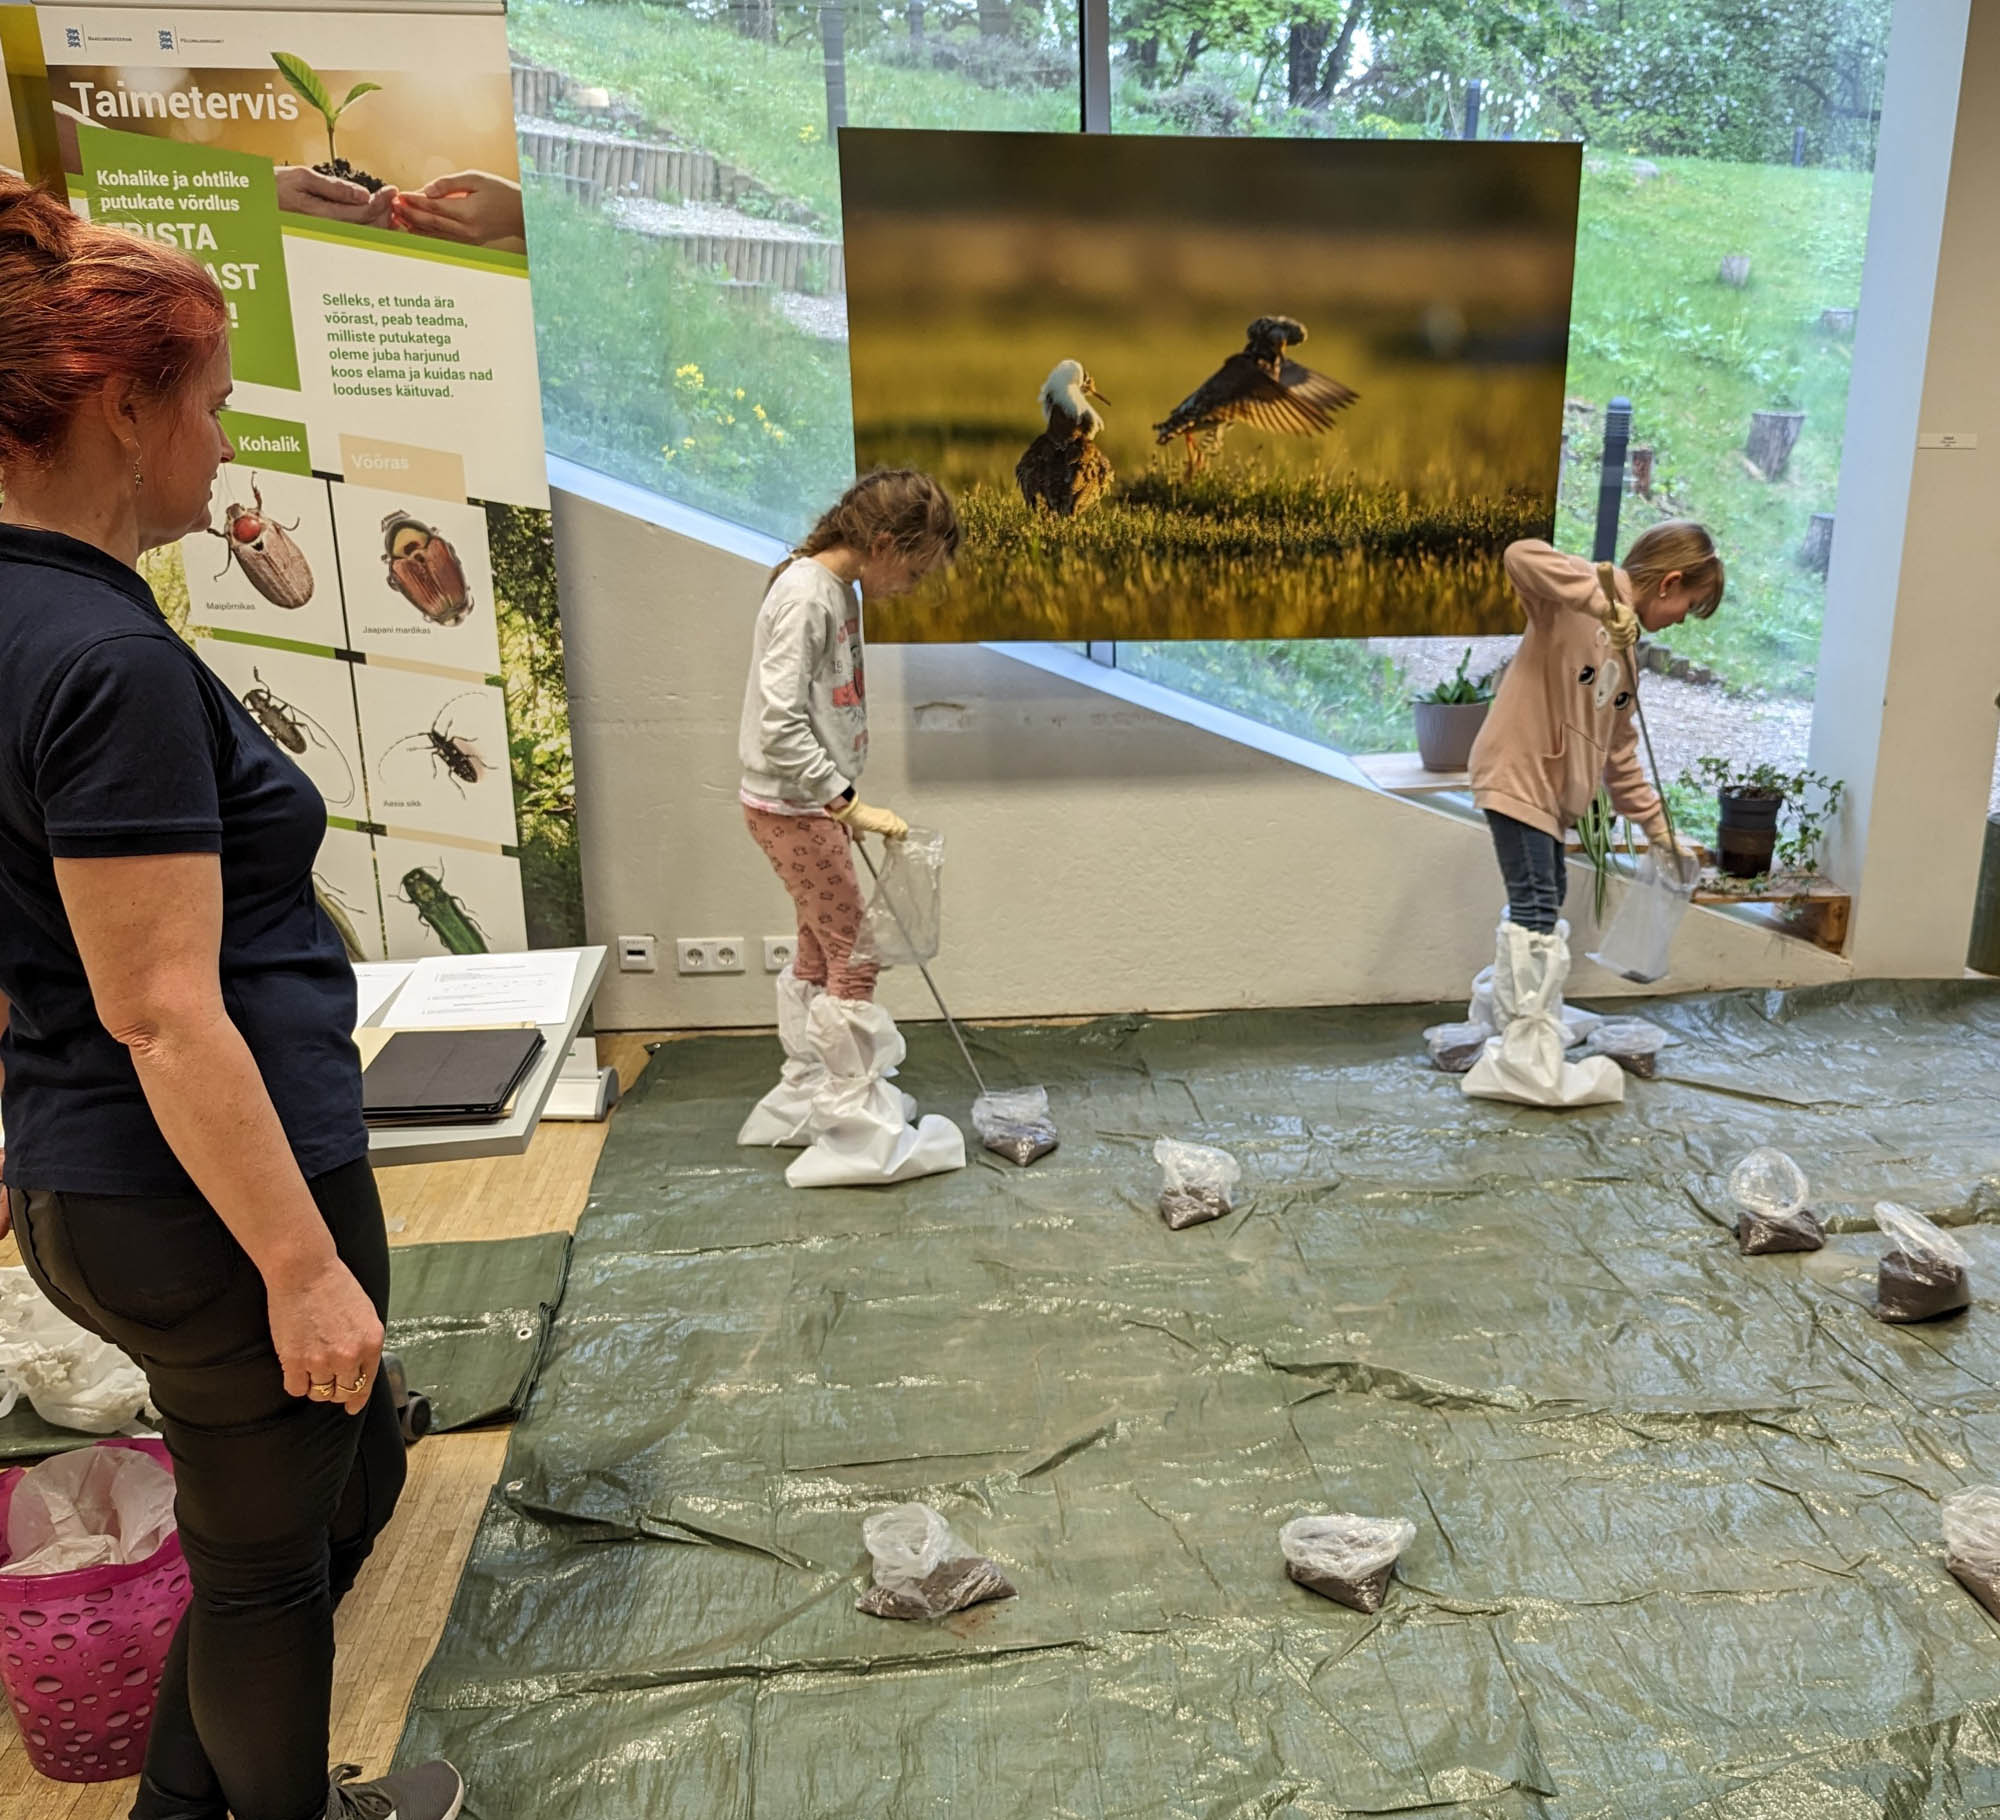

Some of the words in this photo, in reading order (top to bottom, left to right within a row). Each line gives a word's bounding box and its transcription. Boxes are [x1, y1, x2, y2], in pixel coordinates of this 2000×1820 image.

[69, 81, 299, 120] Taimetervis
[96, 169, 169, 187] Kohalike
[173, 170, 189, 190] ja
[193, 171, 249, 188] ohtlike
[100, 193, 175, 212] putukate
[178, 194, 240, 211] võrdlus
[322, 293, 375, 309] Selleks,
[378, 296, 391, 307] et
[394, 295, 431, 308] tunda
[434, 296, 454, 308] ära
[324, 311, 378, 326] võõrast,
[382, 313, 413, 327] peab
[416, 314, 468, 328] teadma,
[327, 329, 376, 343] milliste
[379, 331, 451, 347] putukatega
[329, 347, 369, 360] oleme
[372, 348, 401, 363] juba
[404, 349, 460, 364] harjunud
[331, 365, 363, 378] koos
[367, 366, 406, 379] elama
[409, 367, 421, 382] ja
[424, 367, 466, 380] kuidas
[469, 368, 493, 381] nad
[333, 383, 392, 396] looduses
[396, 384, 454, 398] käituvad.
[238, 435, 301, 452] Kohalik
